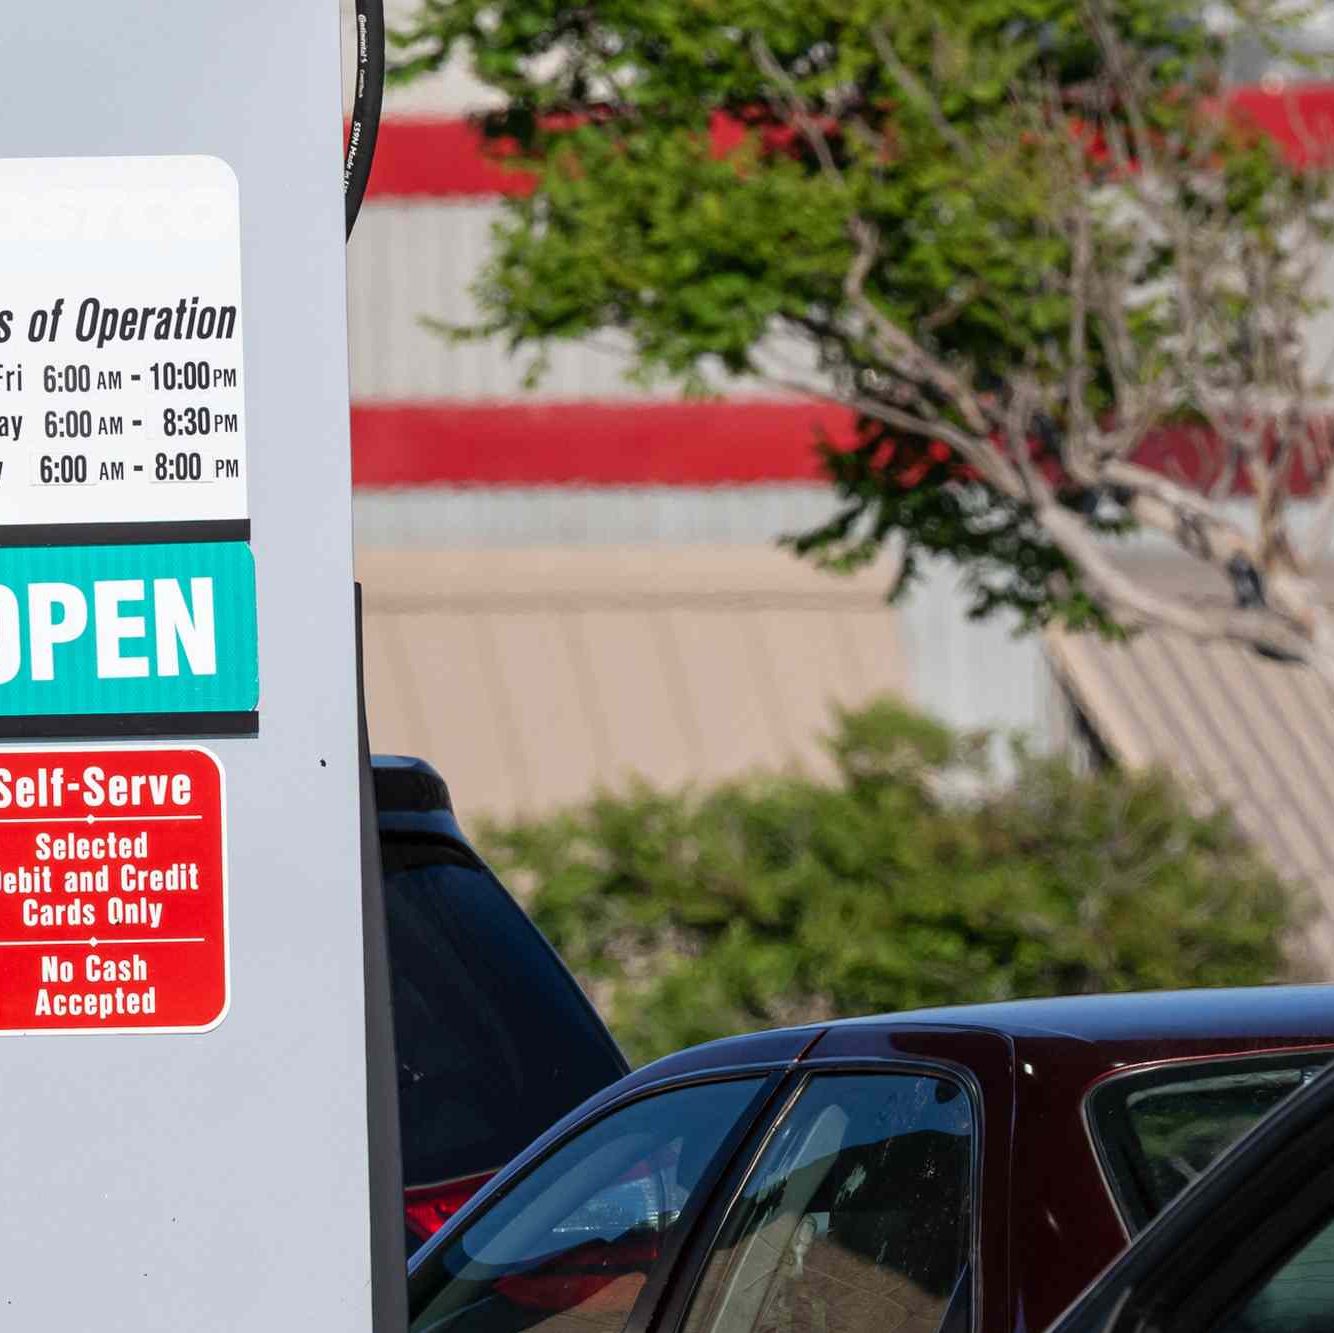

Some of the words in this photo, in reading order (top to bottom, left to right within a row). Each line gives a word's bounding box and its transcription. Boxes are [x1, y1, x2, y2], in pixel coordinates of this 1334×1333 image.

[28, 299, 64, 343] of
[76, 297, 236, 348] Operation
[43, 364, 90, 393] 6:00
[97, 370, 122, 390] AM
[44, 410, 92, 438] 6:00
[98, 416, 123, 435] AM
[40, 455, 87, 483] 6:00
[99, 461, 124, 480] AM
[155, 453, 202, 481] 8:00
[215, 459, 239, 478] PM
[35, 832, 148, 860] Selected
[64, 864, 109, 892] and
[120, 863, 199, 892] Credit
[22, 899, 95, 927] Cards
[107, 897, 163, 929] Only
[41, 955, 74, 983] No
[85, 955, 147, 982] Cash
[34, 987, 156, 1019] Accepted
